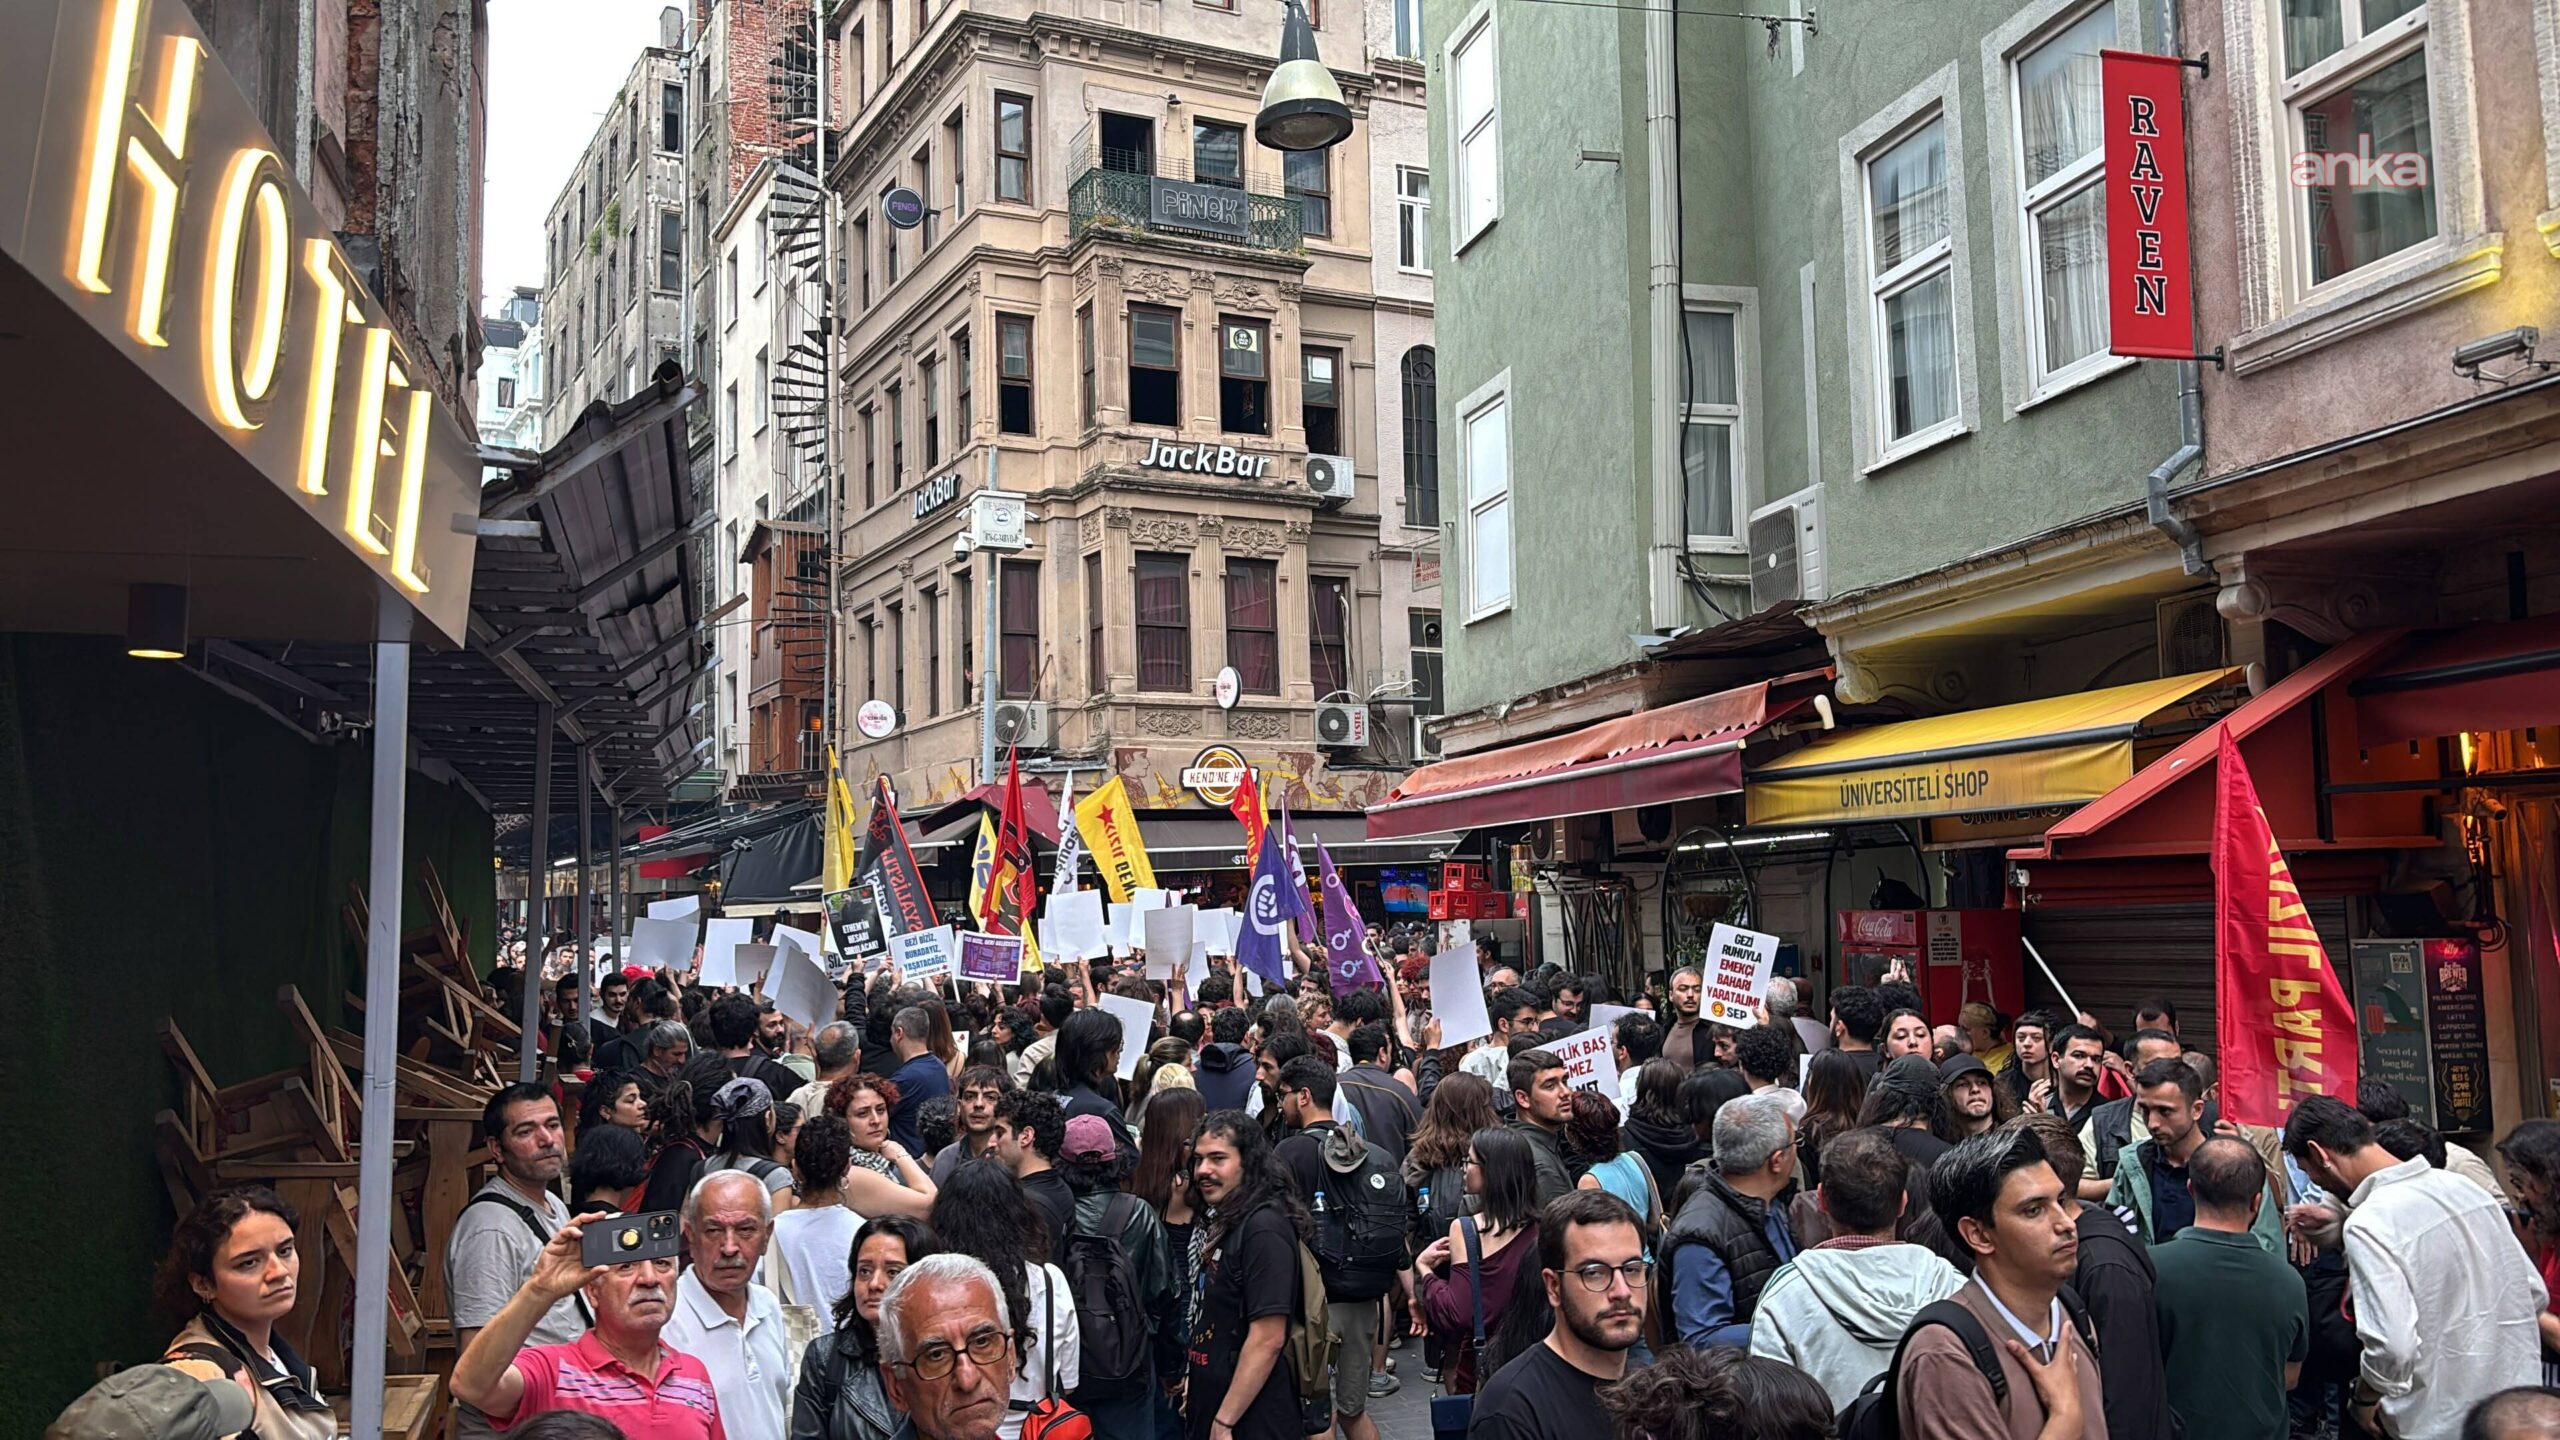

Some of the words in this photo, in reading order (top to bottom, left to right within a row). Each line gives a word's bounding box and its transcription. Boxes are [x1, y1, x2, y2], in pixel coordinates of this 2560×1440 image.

[2128, 95, 2167, 315] RAVEN
[75, 0, 430, 593] HOTEL
[1139, 437, 1272, 478] JackBar
[912, 474, 961, 519] JackBar
[1354, 709, 1362, 741] VESTEL
[1840, 769, 1940, 808] ÜNİVERSİTELİ
[1944, 769, 1989, 799] SHOP
[1734, 934, 1754, 947] GEZİ
[1721, 944, 1762, 963] RUHUYLA
[1719, 958, 1755, 978] EMEKÇİ
[1716, 973, 1752, 991] BAHARI
[1706, 985, 1761, 1009] YARATALIM!
[1726, 1007, 1747, 1020] SEP
[1582, 1036, 1606, 1055] BAŞ
